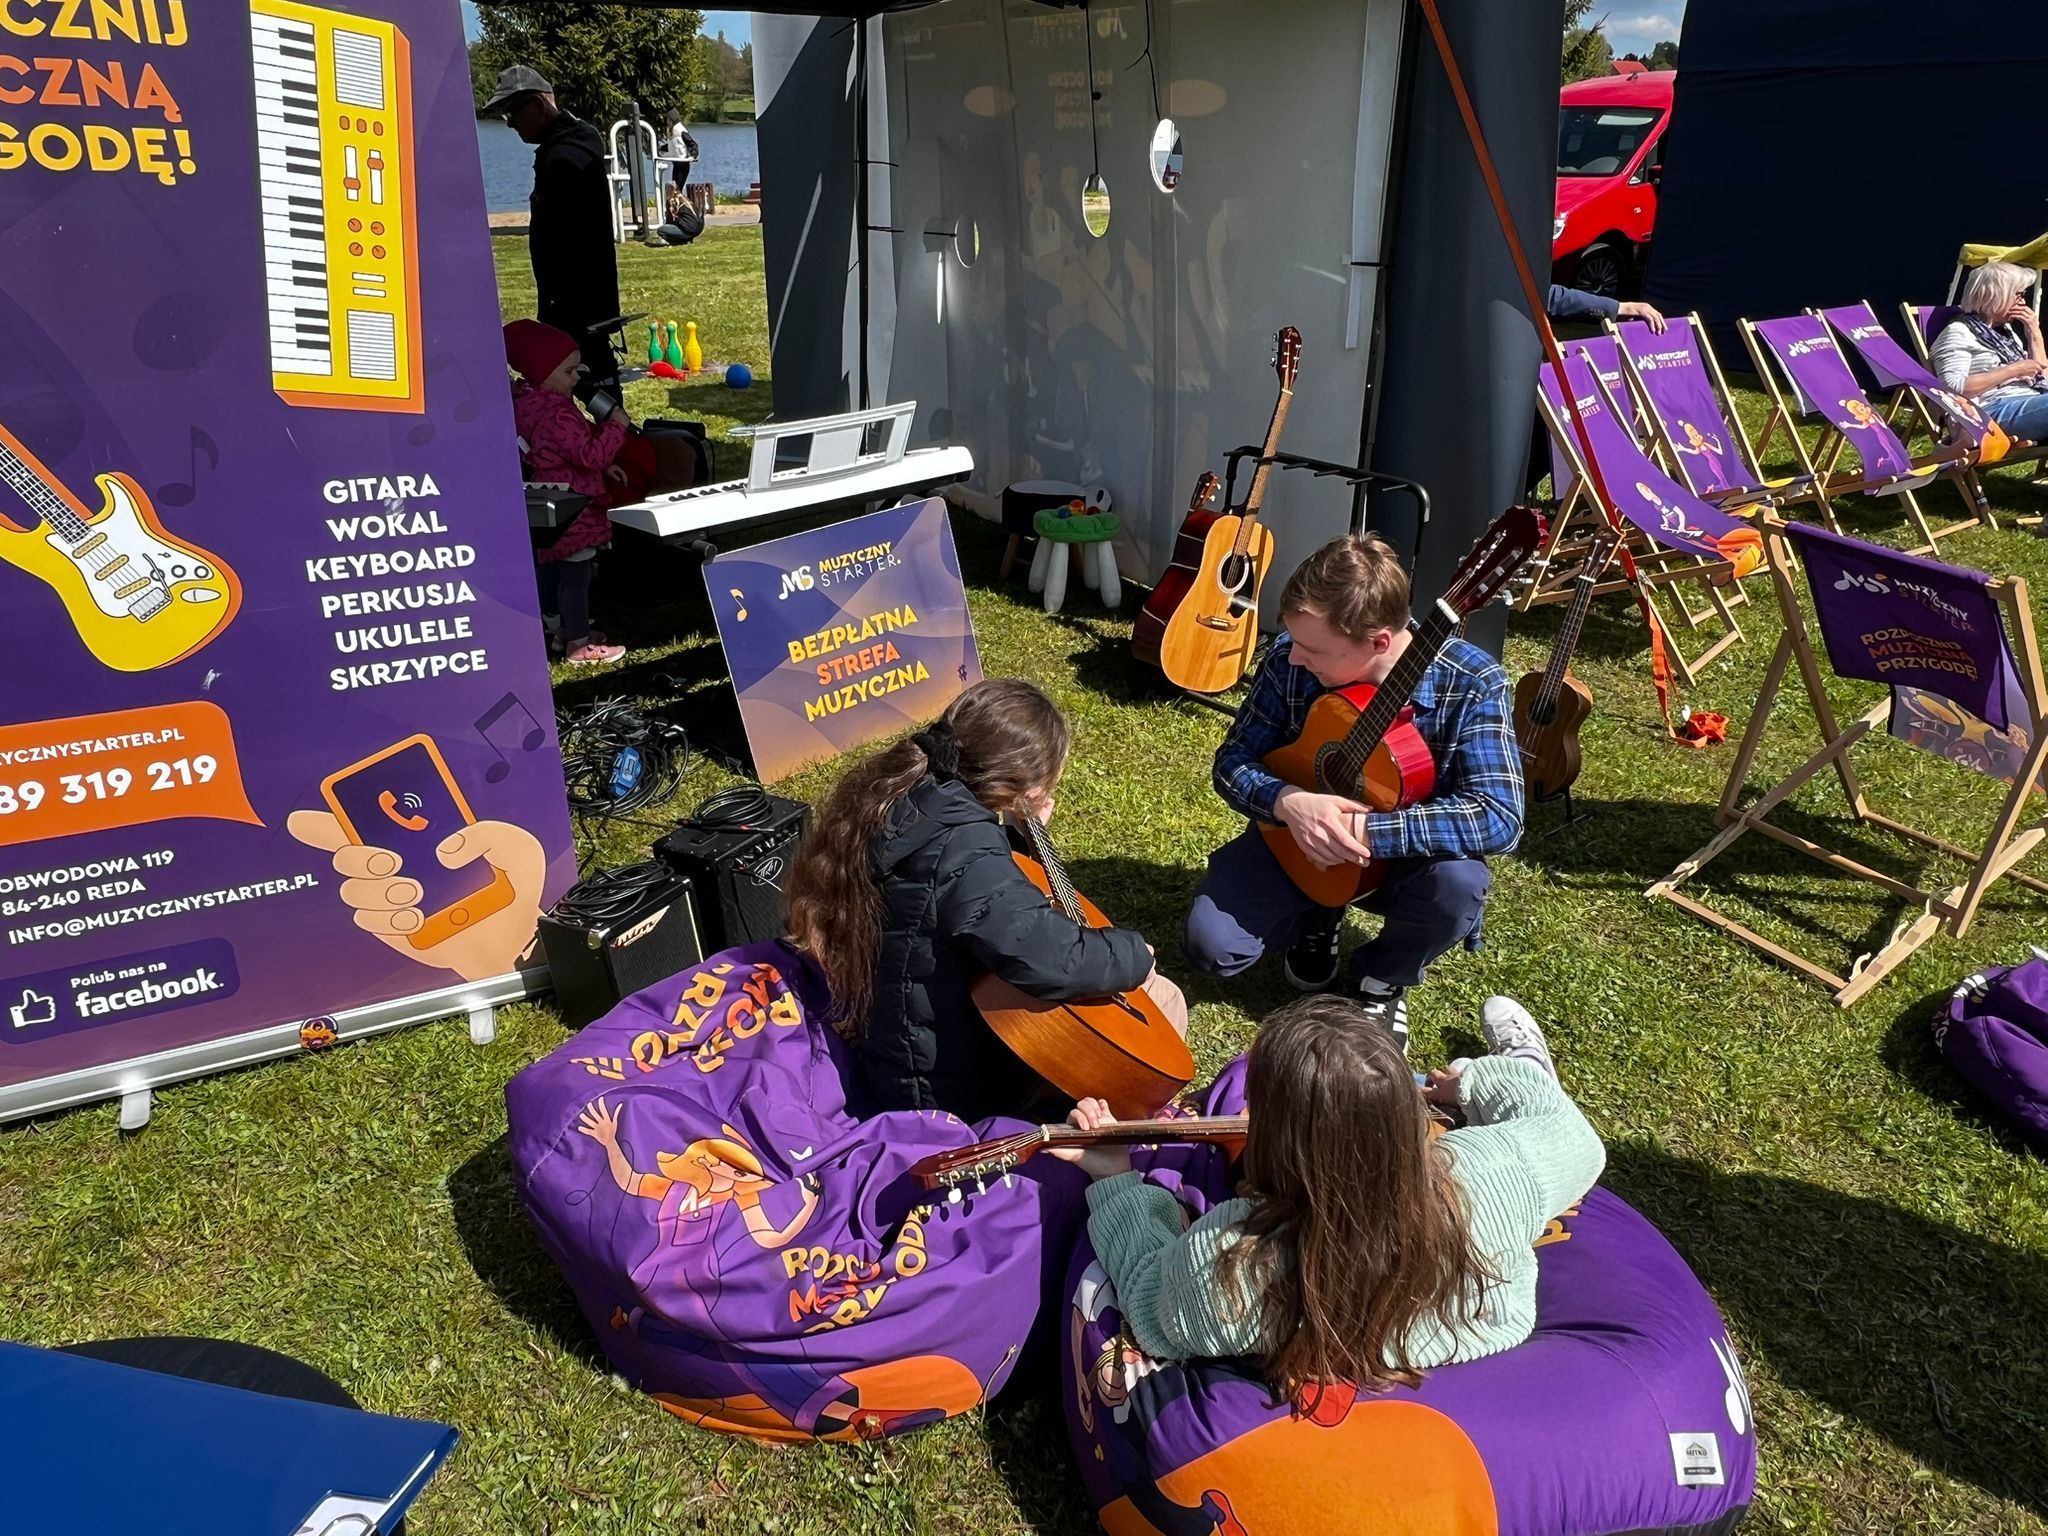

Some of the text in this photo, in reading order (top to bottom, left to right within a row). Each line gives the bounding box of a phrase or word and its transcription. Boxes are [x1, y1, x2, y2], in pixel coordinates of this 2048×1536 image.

[323, 473, 441, 504] GITARA
[326, 511, 448, 542] WOKAL
[306, 545, 476, 582] KEYBOARD
[818, 541, 892, 573] MUZYCZNY
[321, 580, 477, 618] PERKUSJA
[335, 616, 473, 653] UKULELE
[787, 604, 918, 664] BEZPŁATNA
[330, 649, 489, 690] SKRZYPCE
[816, 640, 901, 685] STREFA
[803, 660, 930, 722] MUZYCZNA
[59, 768, 133, 804] 319
[147, 755, 217, 791] 219
[0, 850, 174, 894] OBWODOWA 119
[2, 878, 146, 917] 84-240 REDA
[8, 873, 319, 944] INFO@MUZYCZNYSTARTER.PL
[70, 961, 167, 988] Polub nas na
